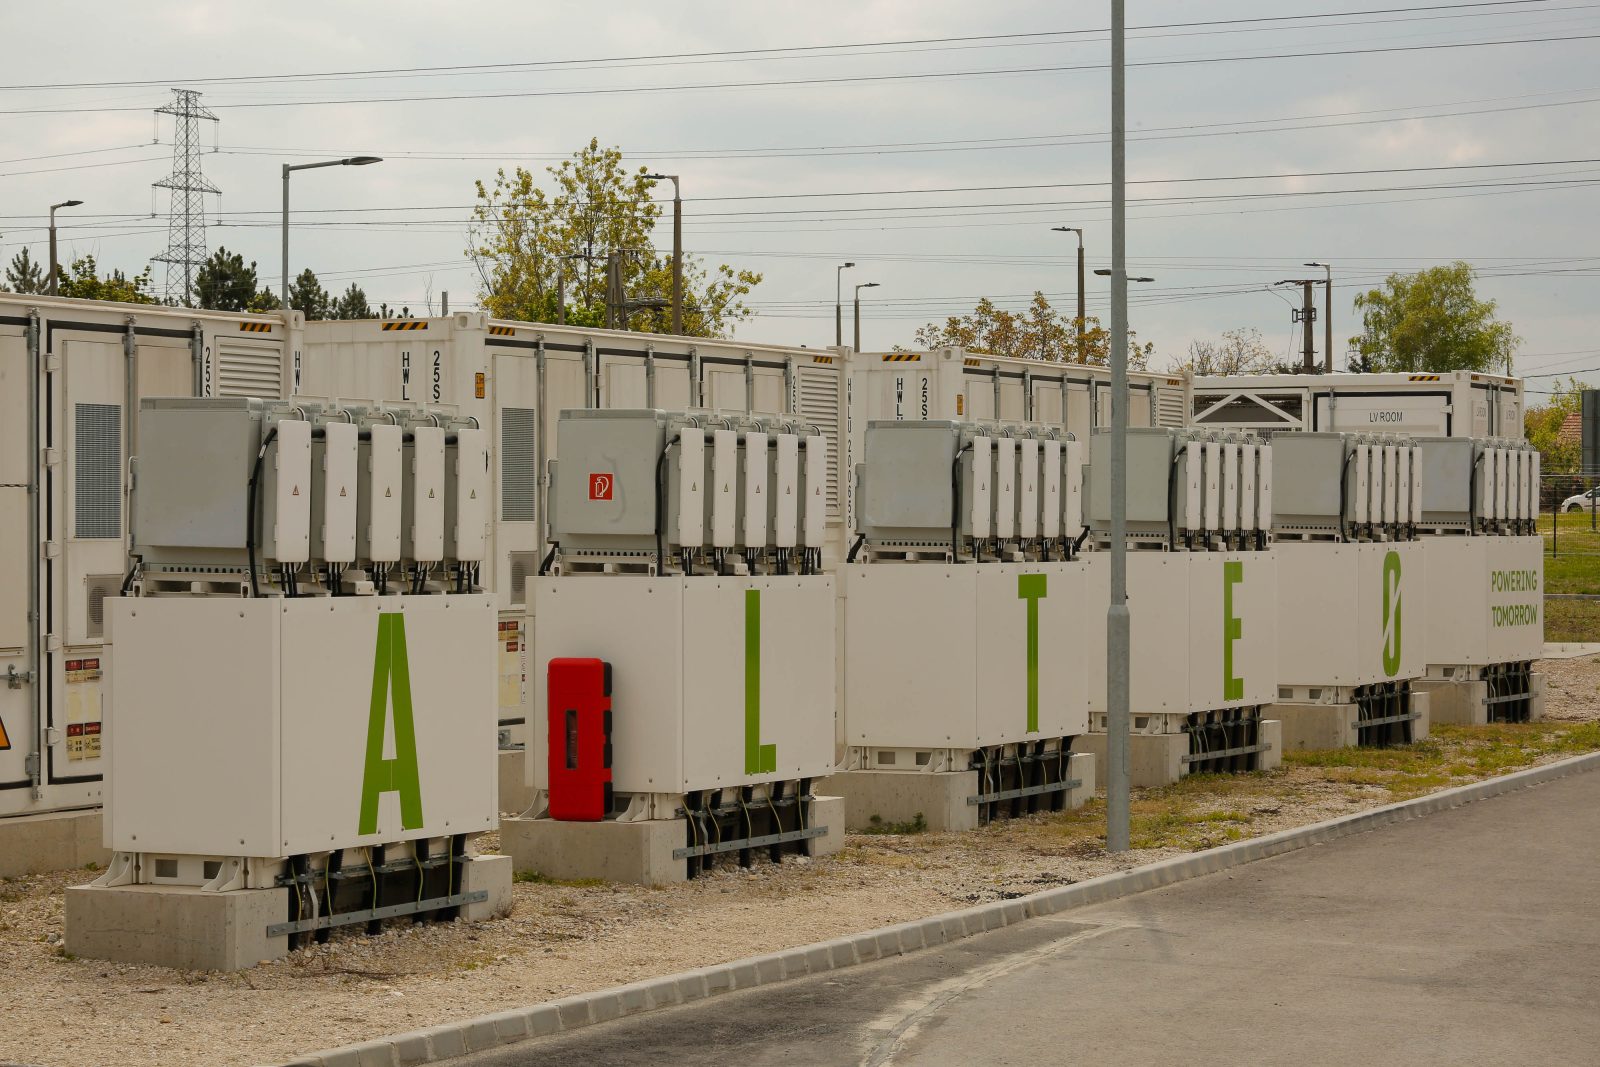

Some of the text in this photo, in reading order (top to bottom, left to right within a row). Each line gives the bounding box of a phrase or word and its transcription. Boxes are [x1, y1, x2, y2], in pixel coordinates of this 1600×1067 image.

[1369, 411, 1403, 423] LV ROOM
[1223, 561, 1244, 701] E
[1491, 569, 1538, 592] POWERING
[1491, 603, 1538, 627] TOMORROW
[745, 590, 777, 775] L
[1018, 574, 1047, 733] T
[358, 613, 424, 835] A
